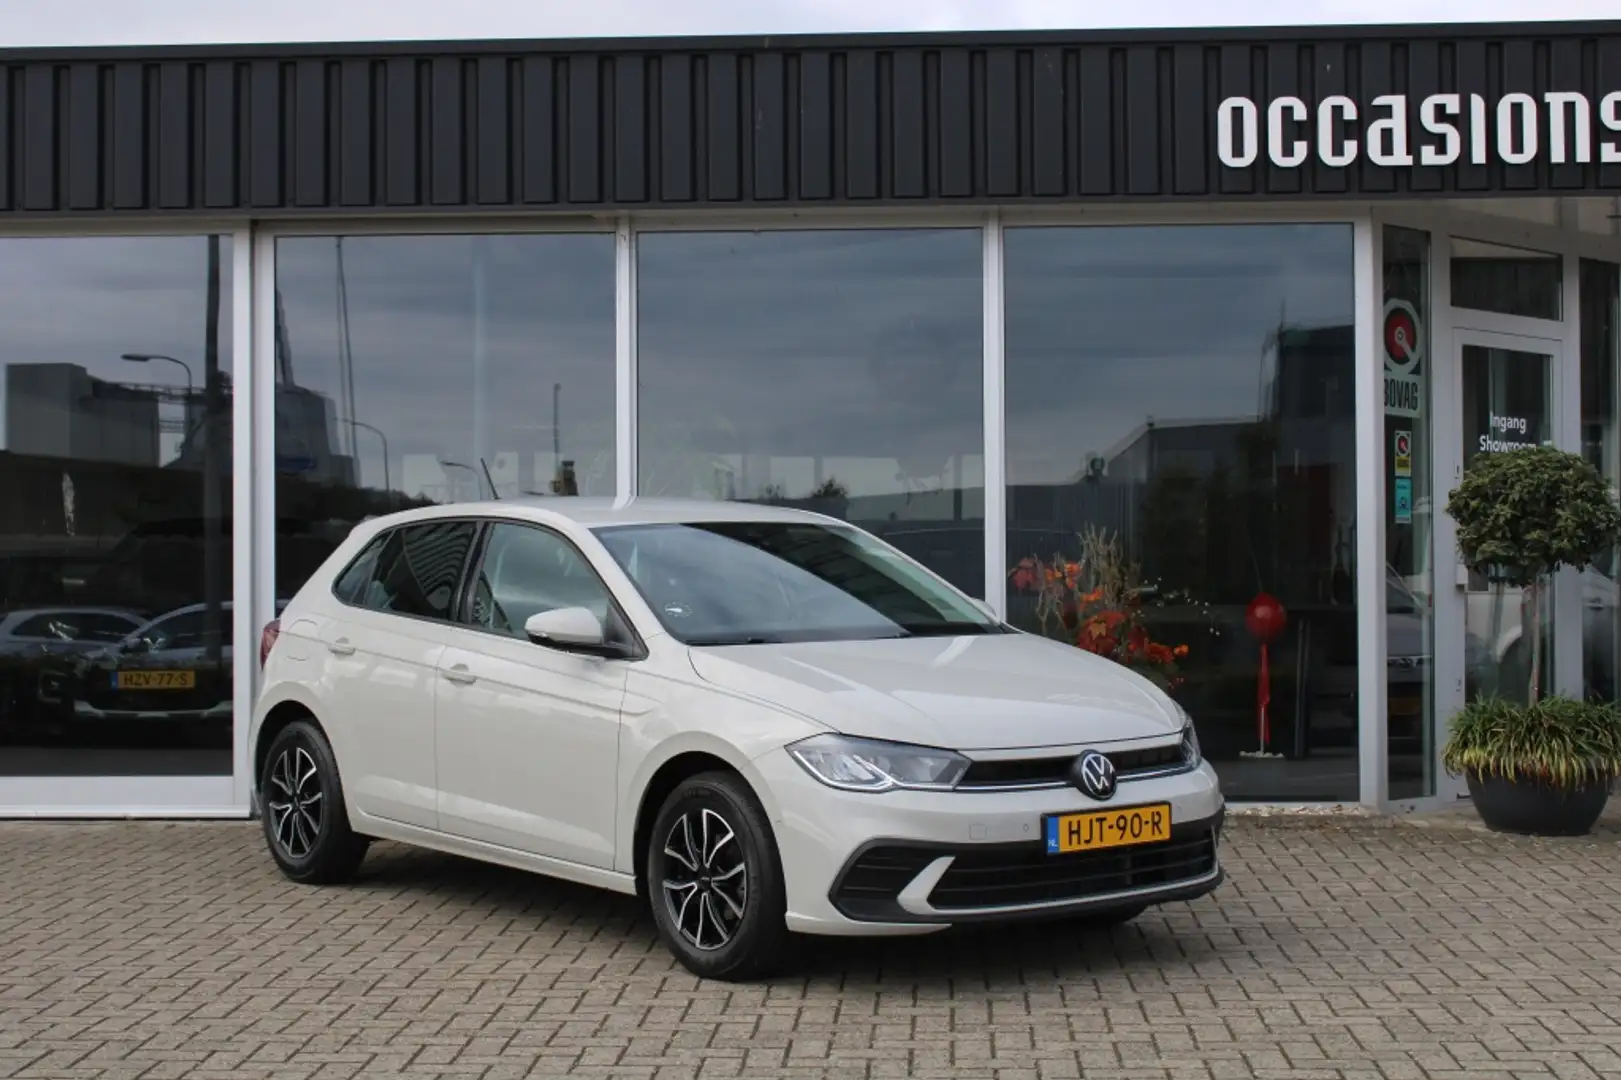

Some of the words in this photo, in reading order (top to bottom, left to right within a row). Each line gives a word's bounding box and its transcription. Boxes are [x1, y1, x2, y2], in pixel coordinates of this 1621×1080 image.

[1490, 410, 1526, 434] Ingang
[123, 672, 188, 686] HZV-77-S
[1067, 811, 1163, 846] HJT-90-R
